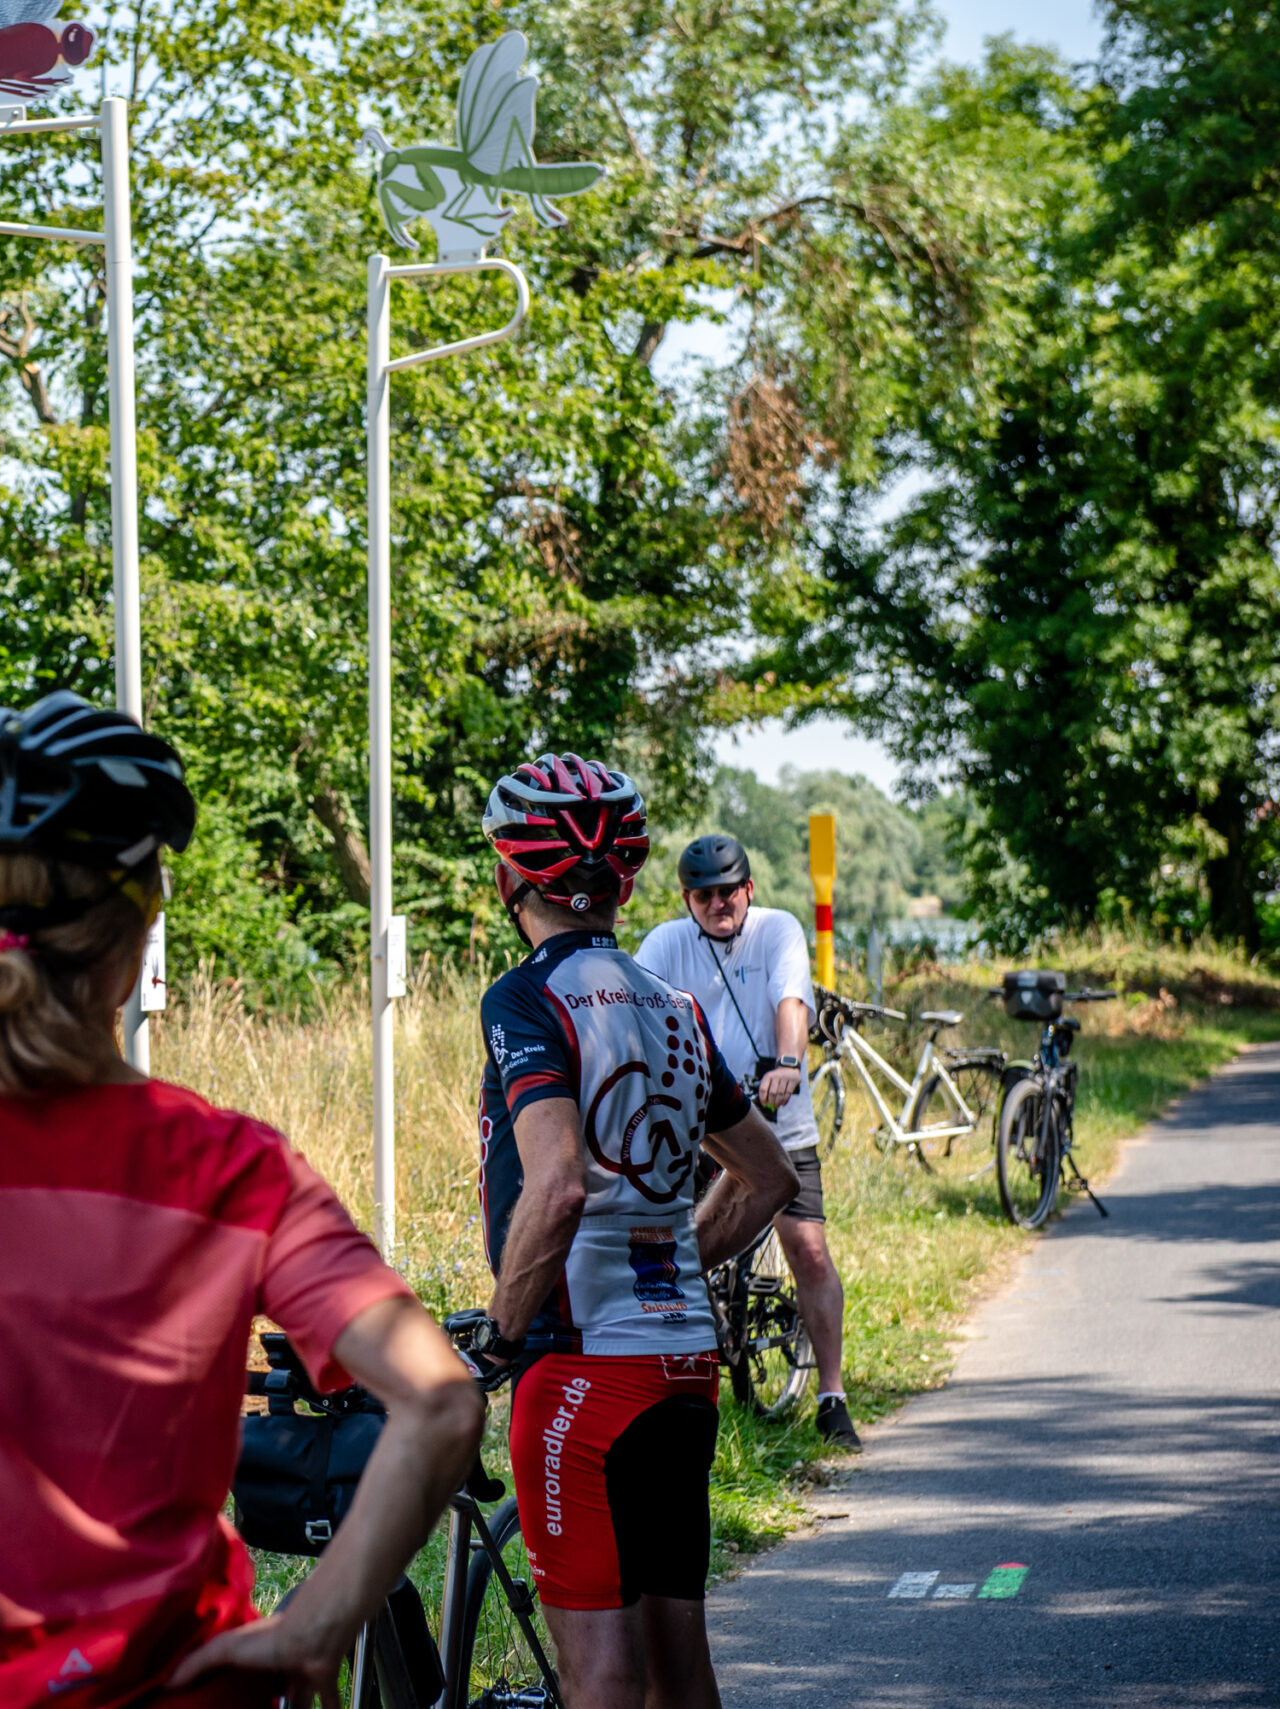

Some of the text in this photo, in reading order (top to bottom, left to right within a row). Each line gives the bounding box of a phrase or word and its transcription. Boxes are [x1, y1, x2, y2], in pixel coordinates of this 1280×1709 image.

[564, 993, 594, 1010] Der
[523, 1044, 546, 1054] Kreis
[542, 1377, 592, 1536] euroradler.de
